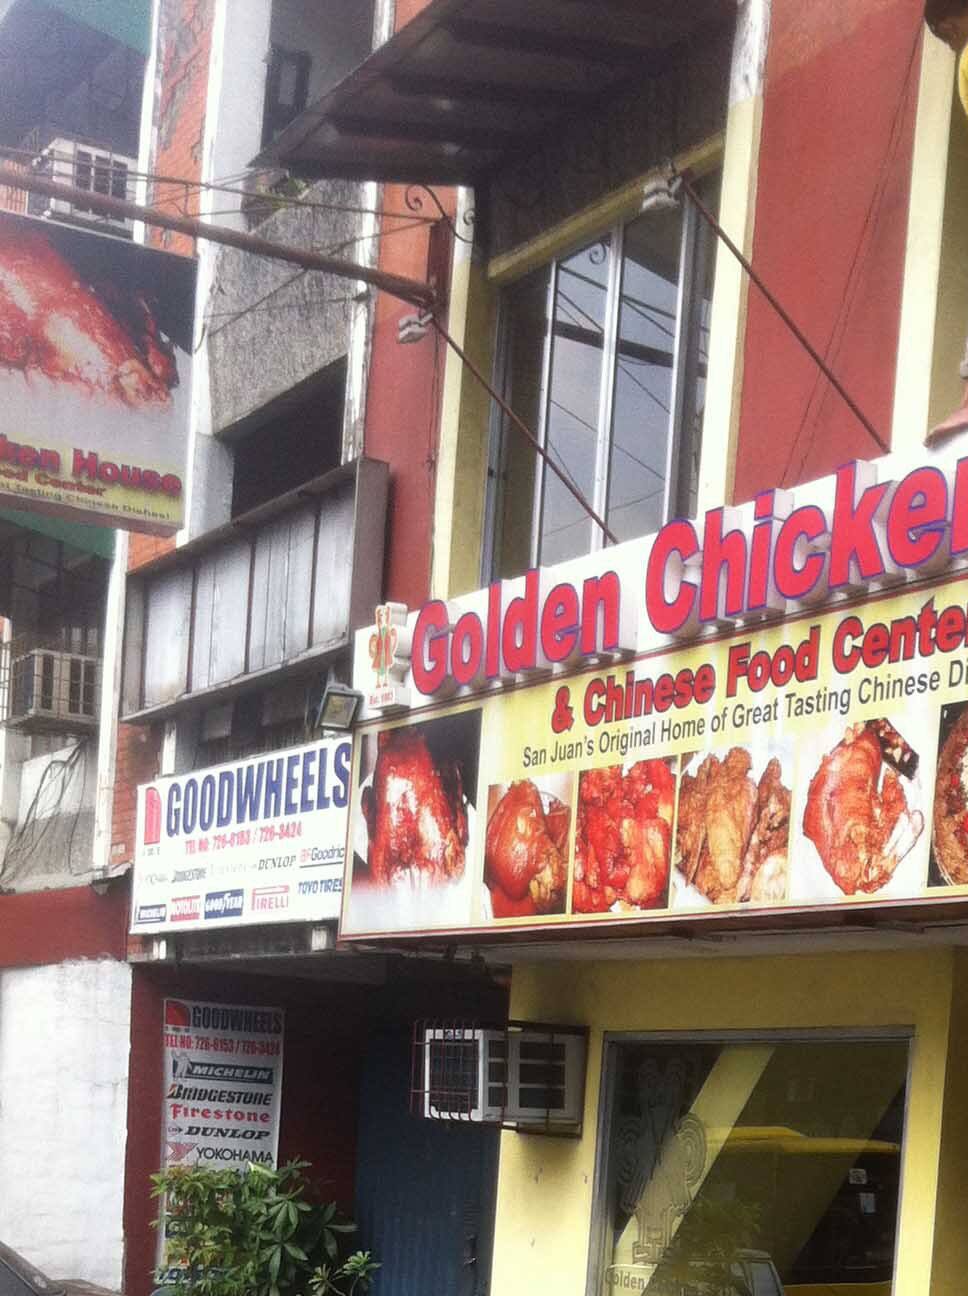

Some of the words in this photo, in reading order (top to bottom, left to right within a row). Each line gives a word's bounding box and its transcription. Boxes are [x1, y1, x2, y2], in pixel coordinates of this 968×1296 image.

[72, 447, 183, 499] House
[411, 569, 622, 696] Golden
[551, 685, 574, 734] &
[583, 662, 716, 727] Chinese
[726, 623, 821, 698] Food
[522, 744, 547, 769] San
[550, 733, 595, 763] Juan's
[598, 719, 656, 755] Original
[660, 710, 707, 742] Home
[710, 707, 728, 734] of
[731, 698, 779, 730] Great
[783, 684, 852, 722] Tasting
[858, 665, 941, 706] Chinese
[166, 742, 352, 837] GOODWHEELS
[257, 854, 297, 871] DUNLOP
[251, 884, 290, 911] PIRELLI
[191, 1005, 282, 1034] GOODWHEELS
[191, 1065, 271, 1081] MICHELIN
[166, 1083, 272, 1106] BRIDGESTONE
[169, 1103, 271, 1124] Firestone
[185, 1125, 271, 1140] DUNLOP
[196, 1145, 274, 1164] YOKOHAMA
